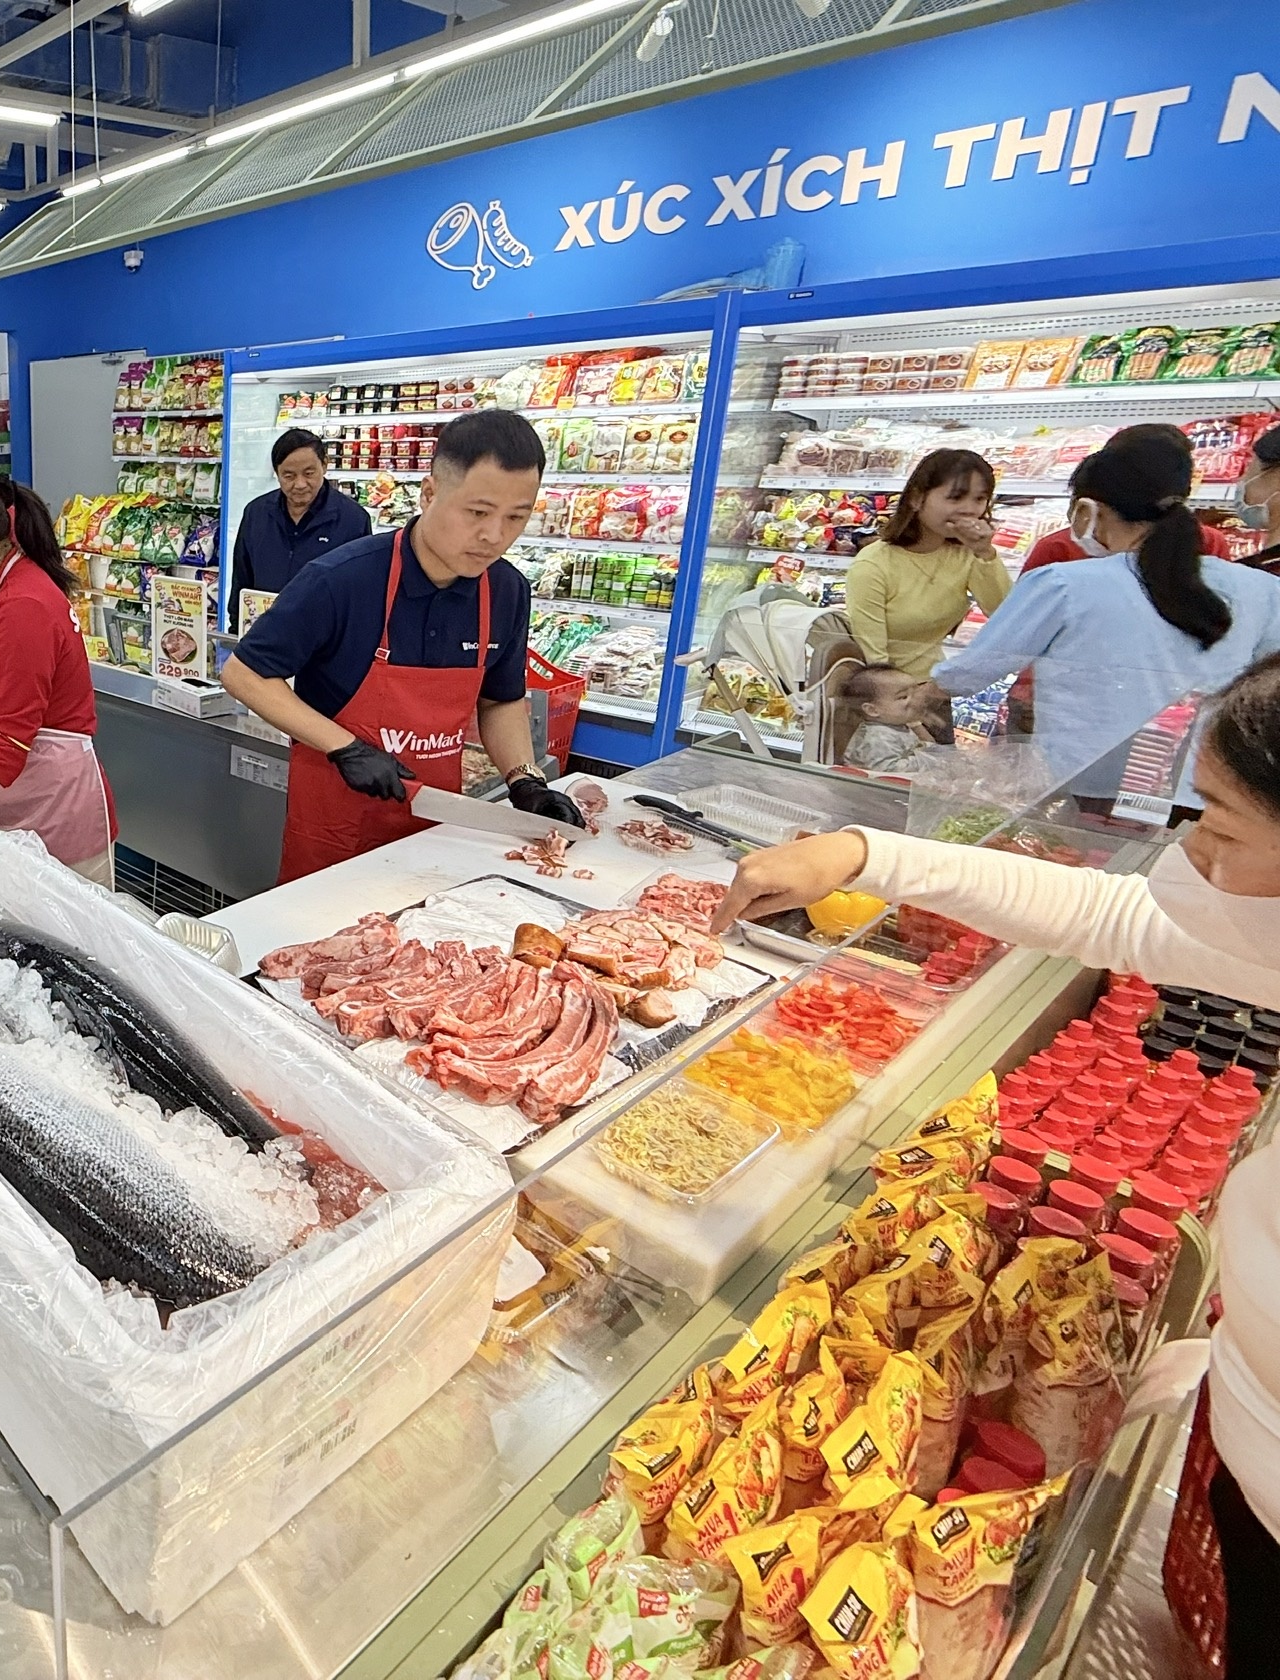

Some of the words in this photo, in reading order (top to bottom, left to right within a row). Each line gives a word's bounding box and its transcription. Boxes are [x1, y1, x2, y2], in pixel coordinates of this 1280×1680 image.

[554, 180, 689, 252] XÚC
[707, 141, 905, 227] XÍCH
[933, 86, 1191, 187] THỊT
[158, 664, 182, 678] 229
[380, 727, 464, 754] WinMart
[846, 1436, 874, 1470] CHIN-SU
[933, 1508, 965, 1540] CHIN-SU
[833, 1592, 863, 1636] CHIN-SU
